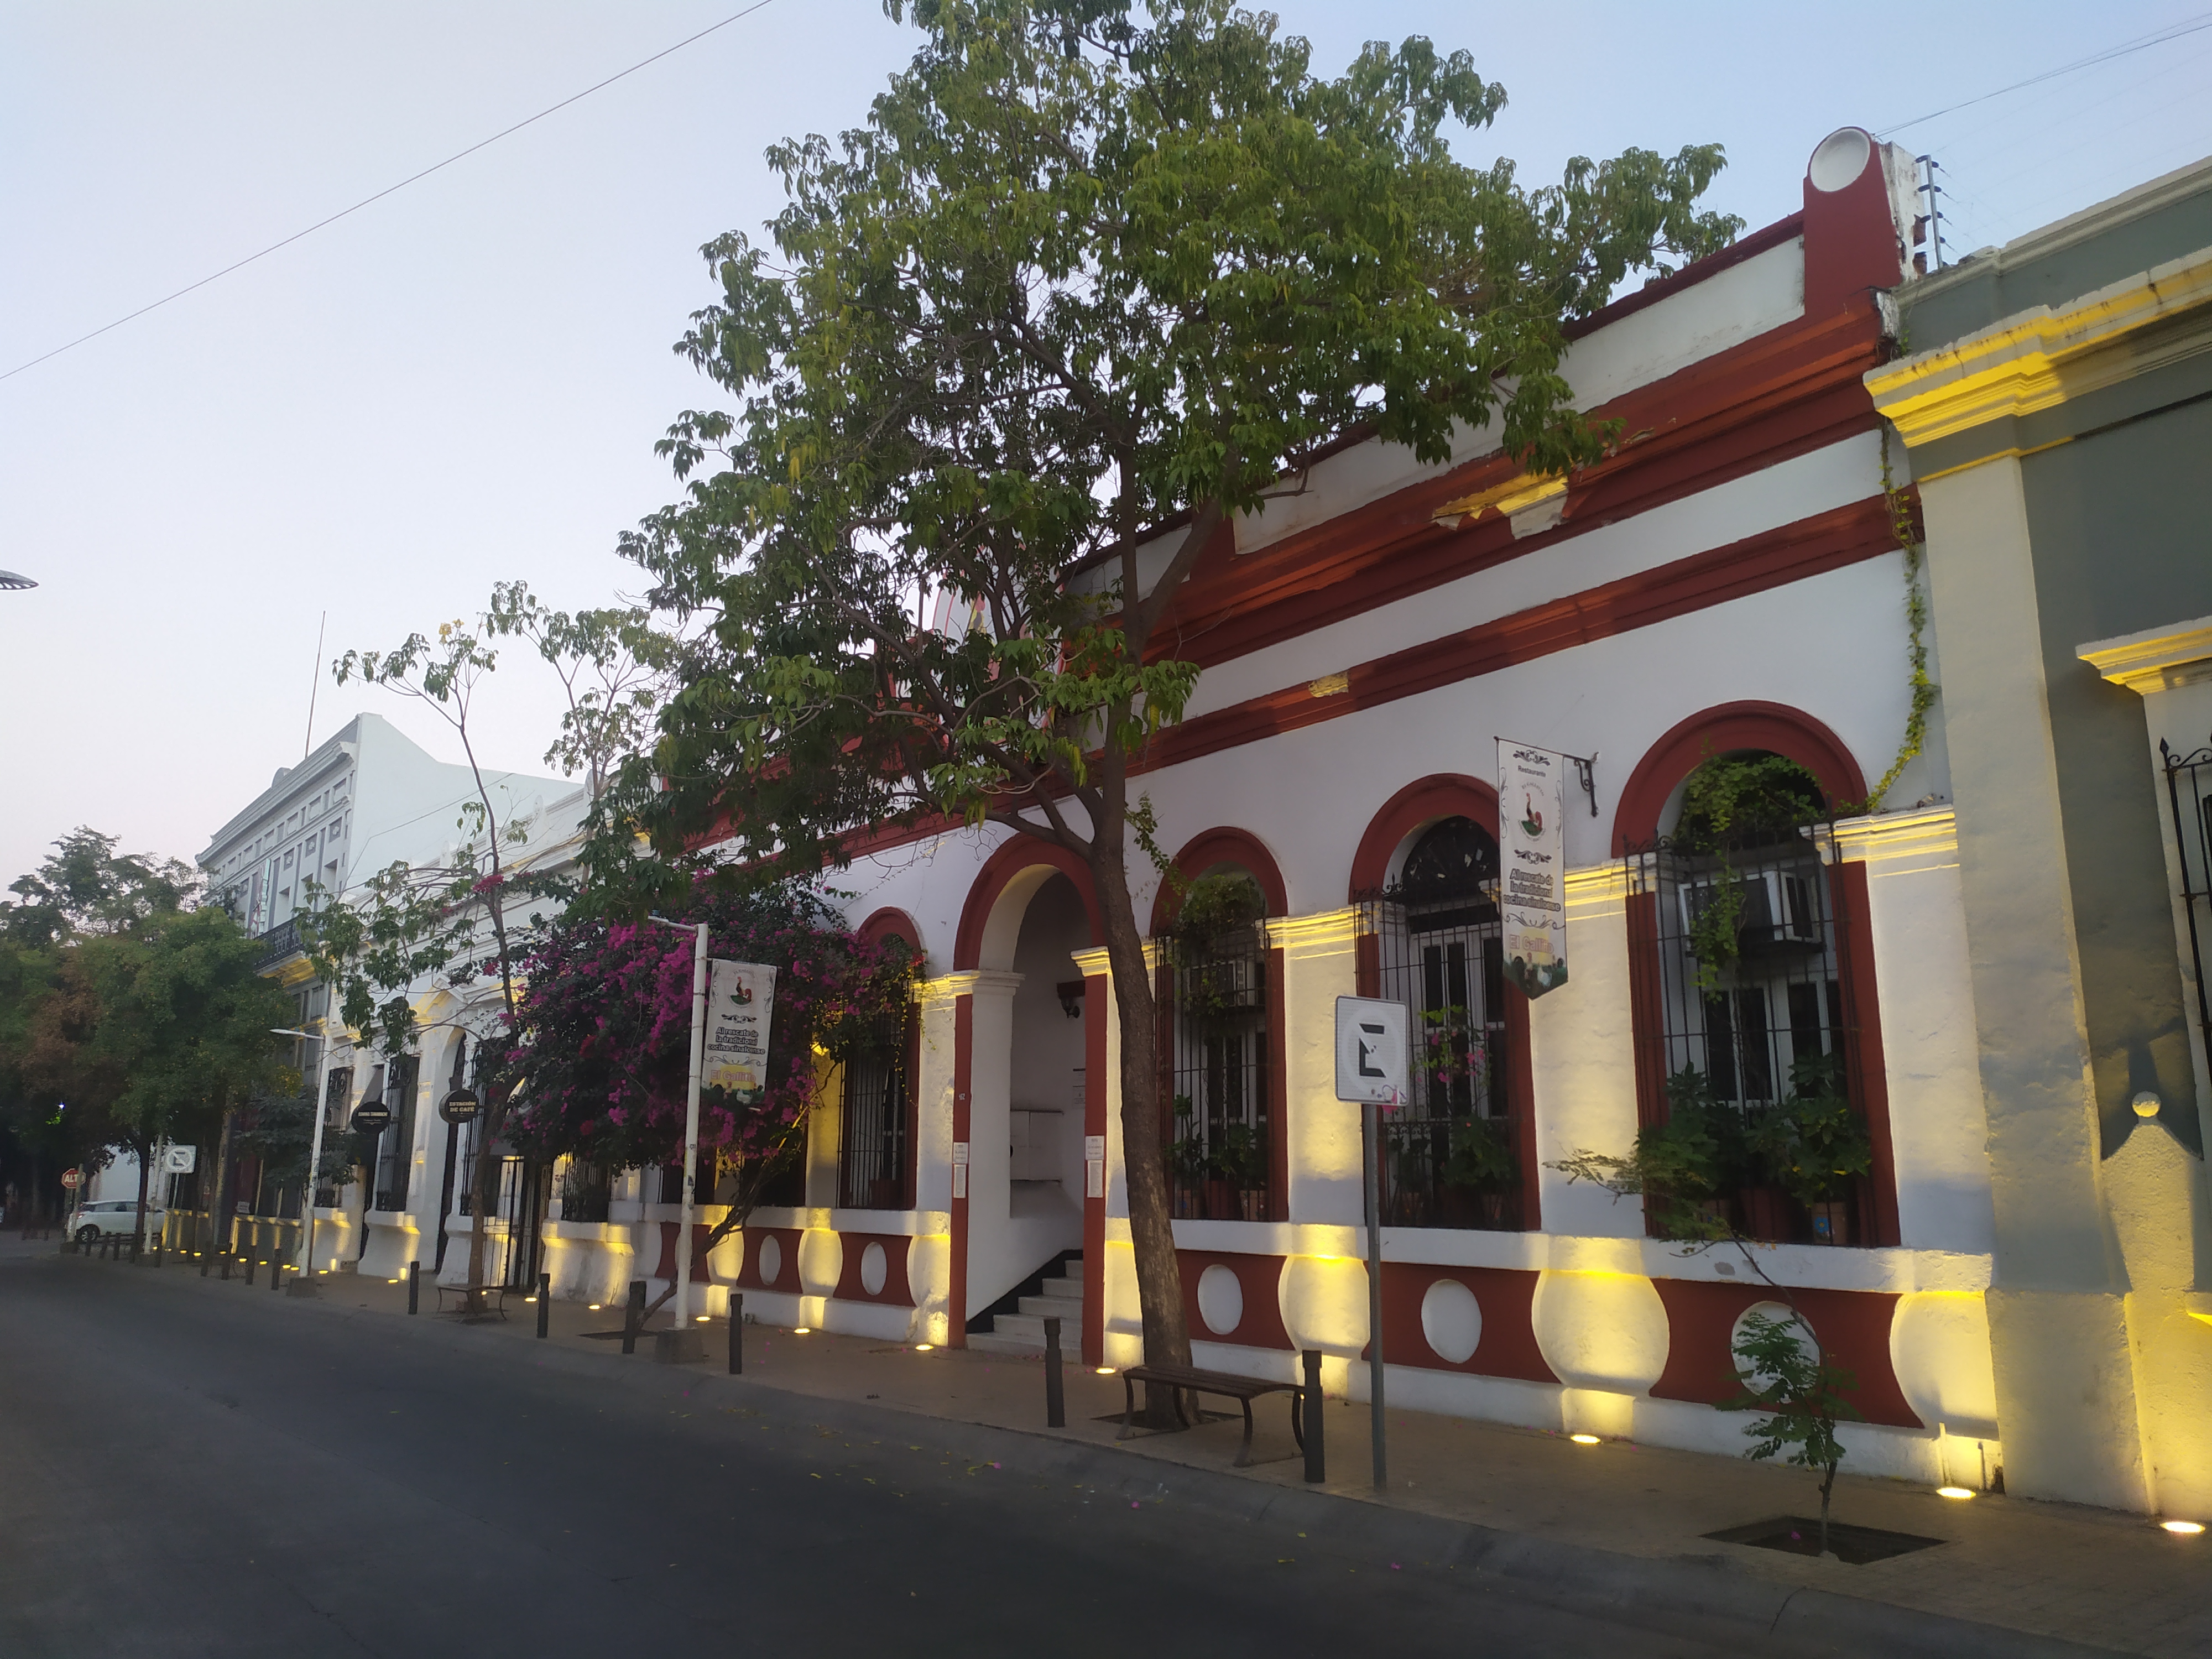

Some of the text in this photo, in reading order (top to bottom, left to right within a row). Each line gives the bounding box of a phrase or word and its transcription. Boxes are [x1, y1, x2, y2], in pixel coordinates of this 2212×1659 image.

[1517, 765, 1546, 778] Restaurante
[1510, 868, 1520, 879] Al
[1521, 872, 1545, 884] rescate
[1511, 881, 1519, 891] la
[1503, 894, 1527, 906] cocina
[1510, 934, 1520, 949] El
[724, 1036, 758, 1045] tradicional
[731, 1045, 765, 1054] sinaloense
[711, 1070, 721, 1079] El
